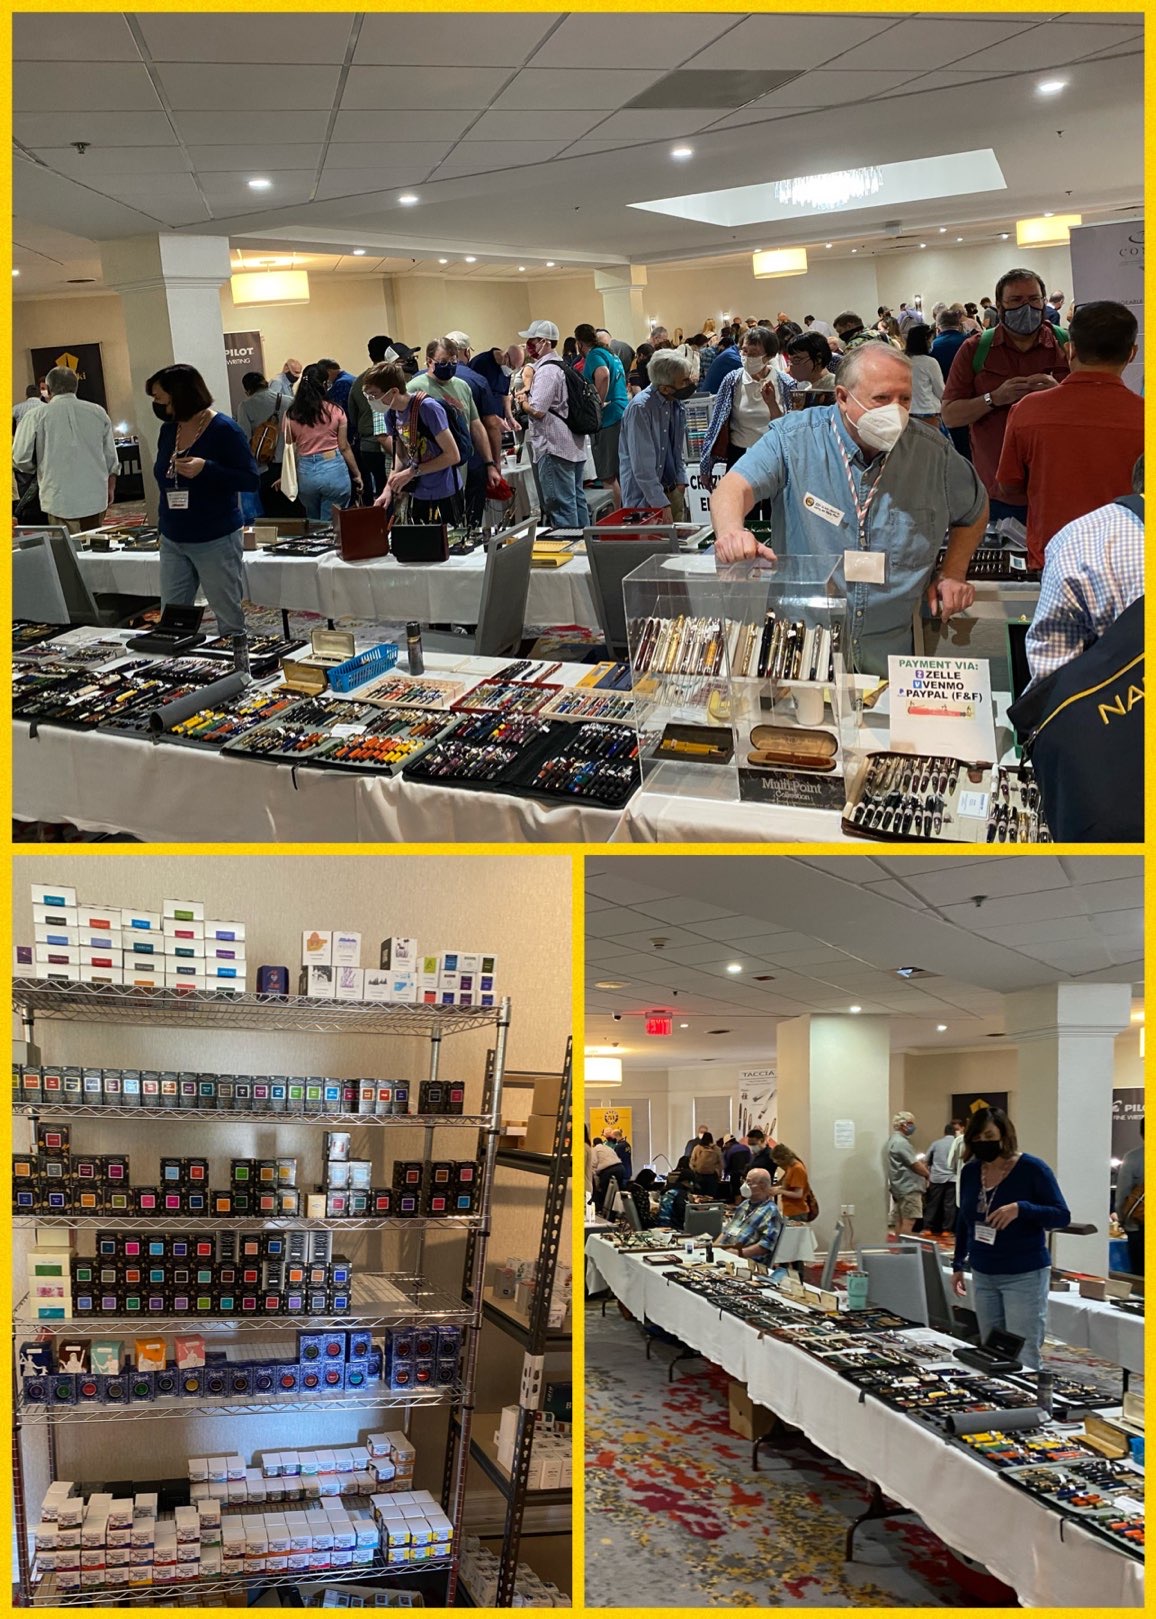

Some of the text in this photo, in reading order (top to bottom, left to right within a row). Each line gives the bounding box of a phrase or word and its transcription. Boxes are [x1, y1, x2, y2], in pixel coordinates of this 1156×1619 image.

[1119, 247, 1144, 257] CO
[224, 347, 254, 357] PILOT
[899, 659, 979, 670] PAYMENT VIA:
[925, 670, 961, 680] ZELLE
[922, 681, 964, 690] VENMO
[906, 689, 983, 703] PAYPAL (F&F)
[743, 1070, 776, 1078] TACCIA
